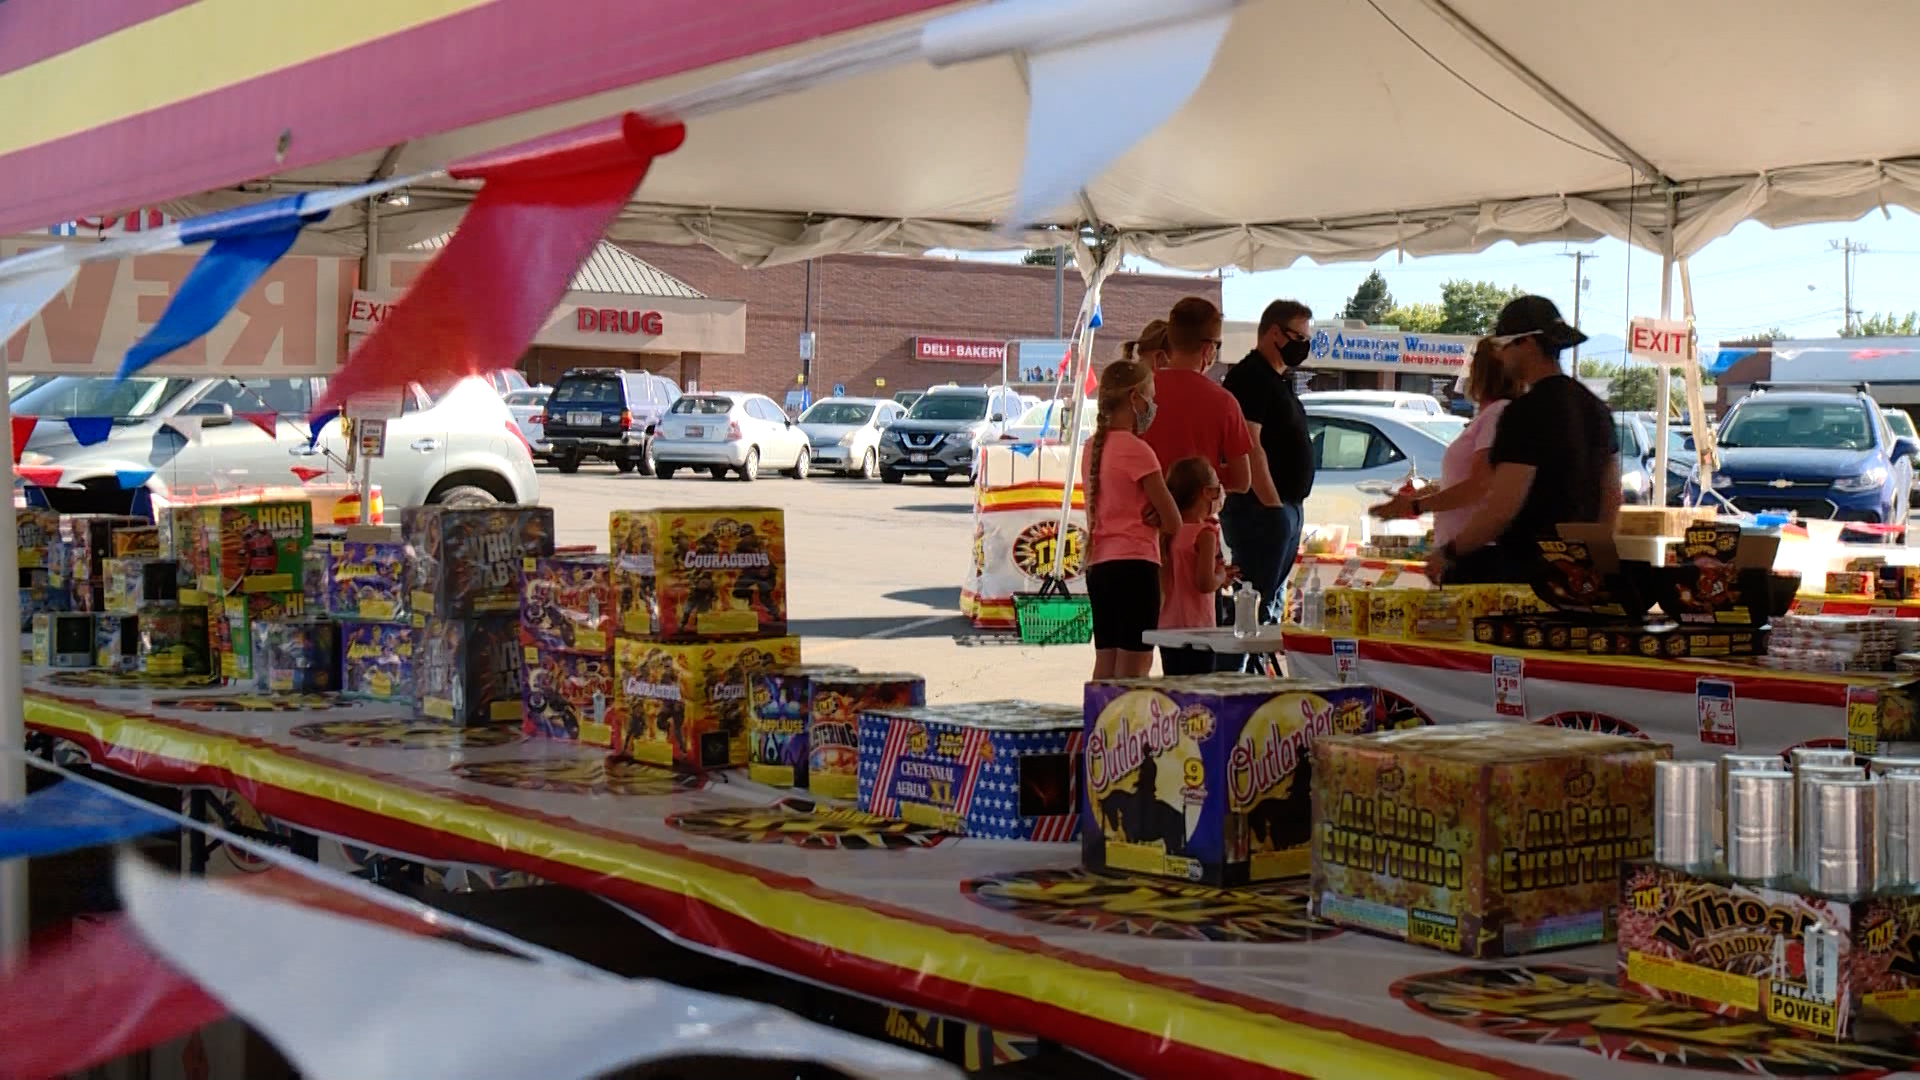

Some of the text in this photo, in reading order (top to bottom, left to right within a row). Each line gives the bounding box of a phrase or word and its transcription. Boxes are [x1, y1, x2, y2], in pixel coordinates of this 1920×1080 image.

[577, 307, 663, 336] DRUG
[1333, 331, 1399, 350] AMERICAN
[1633, 326, 1687, 355] EXIT
[257, 505, 304, 530] HIGH
[1688, 530, 1717, 544] RED
[1085, 698, 1181, 793] Outlander
[900, 760, 956, 783] CENTENNIAL
[1183, 757, 1205, 788] 9
[895, 780, 955, 806] AERIAL XL
[1339, 790, 1436, 845] ALL GOLD
[1525, 802, 1632, 848] ALL GOLD
[1322, 821, 1463, 892] EVERYTHING
[1633, 886, 1661, 909] TNT
[1412, 923, 1457, 945] IMPACT
[1866, 919, 1895, 950] TNT
[1772, 999, 1832, 1027] POWER
